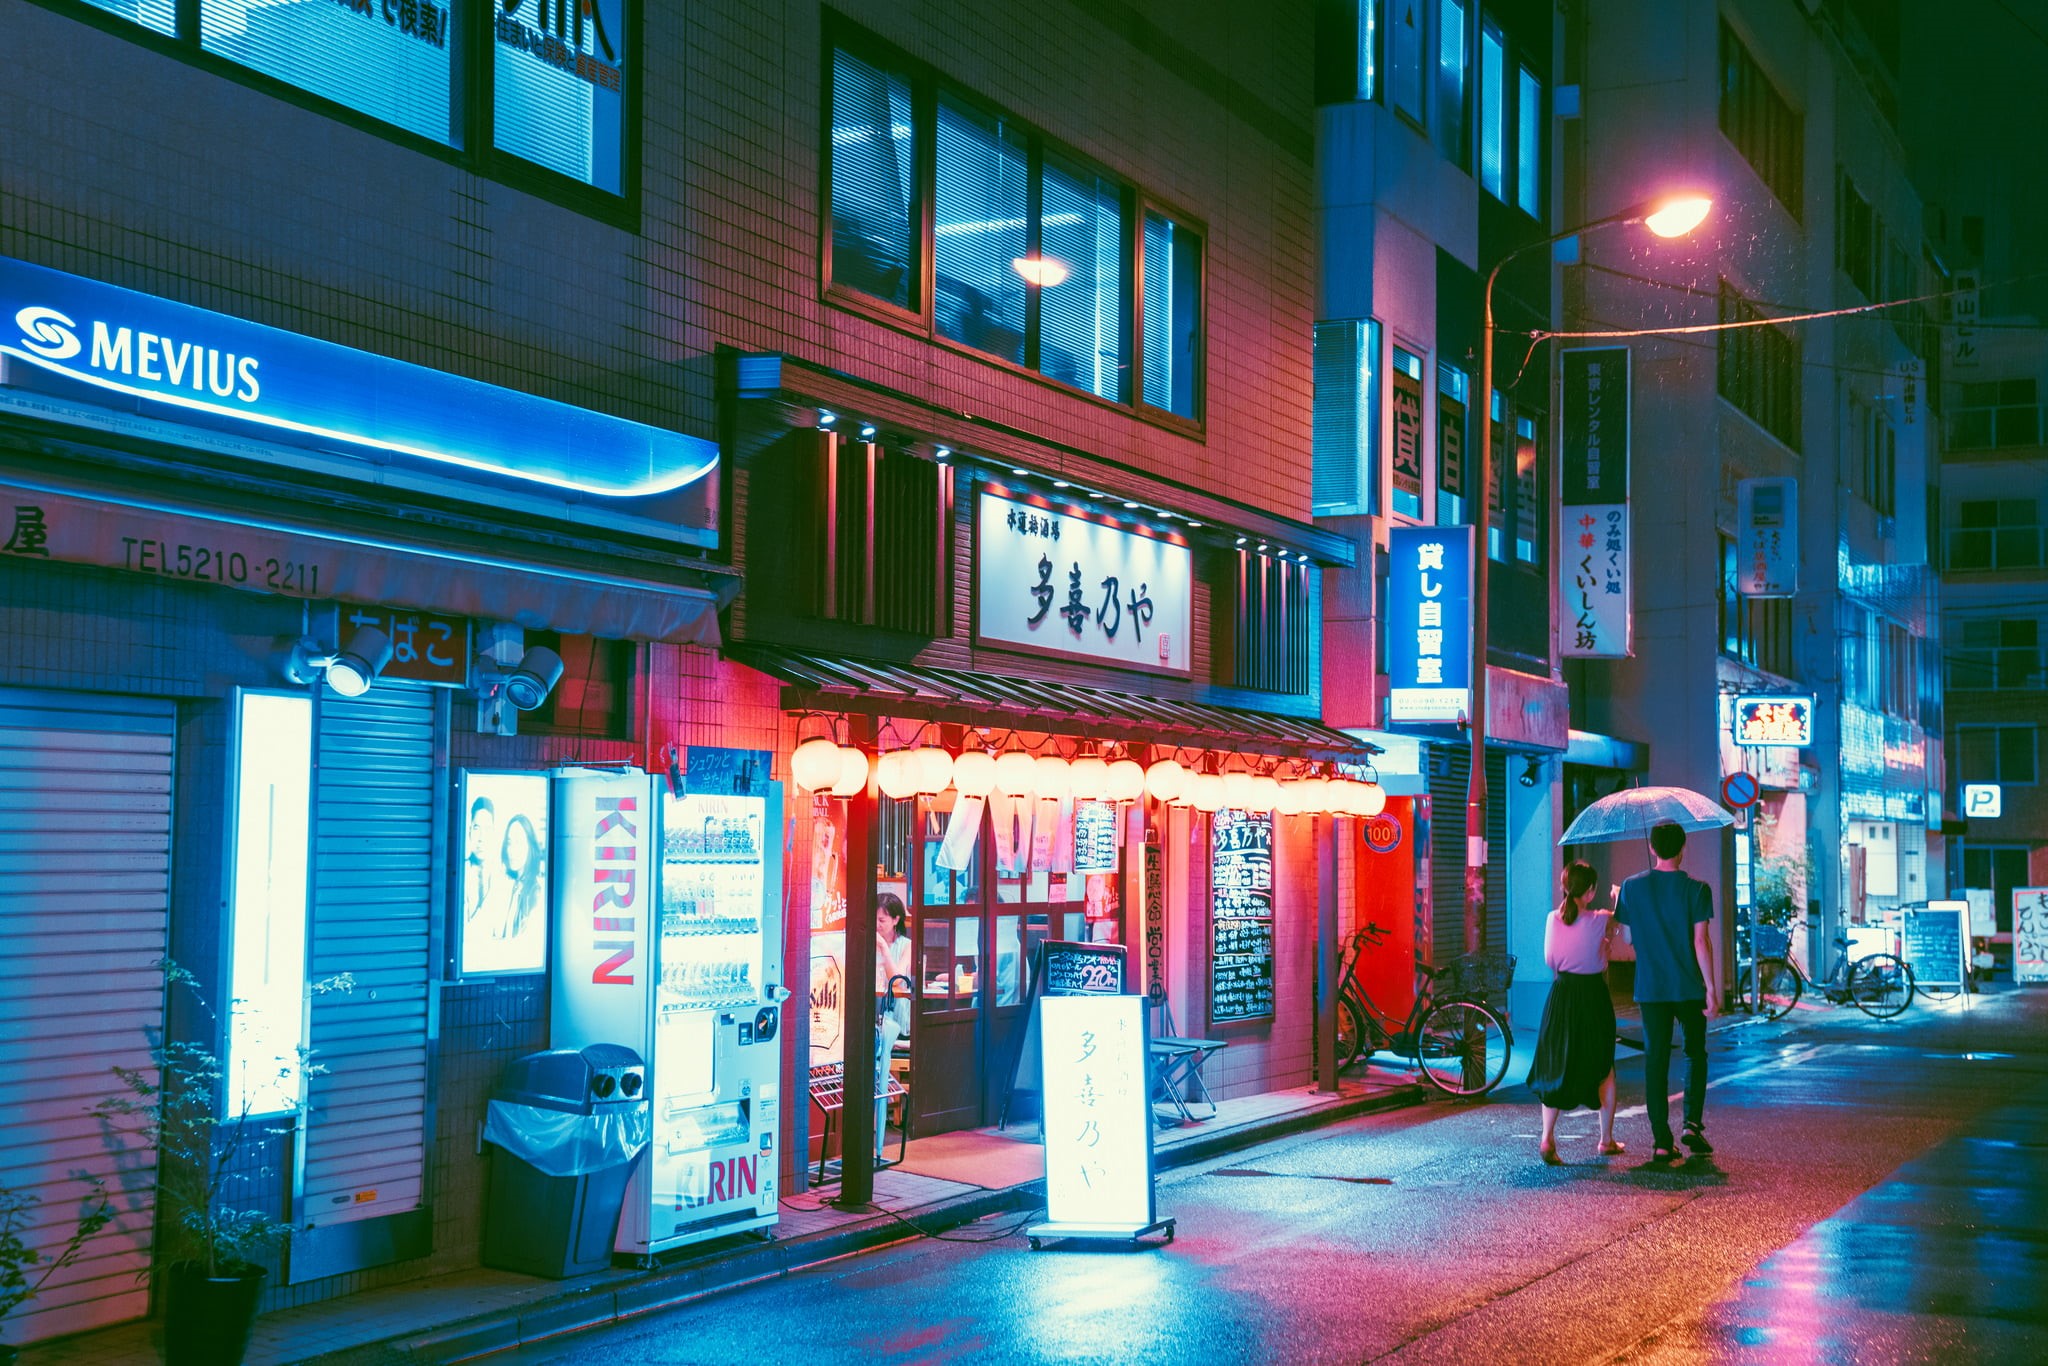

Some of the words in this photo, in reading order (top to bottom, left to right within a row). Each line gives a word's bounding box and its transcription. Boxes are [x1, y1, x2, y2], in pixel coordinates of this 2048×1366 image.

[91, 320, 260, 403] MEVIUS
[1587, 363, 1601, 489] 東京レンタル自習室
[3, 505, 50, 558] 屋
[1578, 513, 1597, 549] 中華
[1606, 510, 1622, 594] のみ処くい処
[1027, 552, 1153, 643] 多喜乃や
[1417, 542, 1444, 684] 貸し自習室
[1575, 554, 1597, 650] くいしん坊
[697, 799, 729, 814] KIRIN
[592, 796, 637, 986] KIRIN
[1074, 1030, 1106, 1189] 多喜乃や
[675, 1154, 758, 1212] KIRIN
